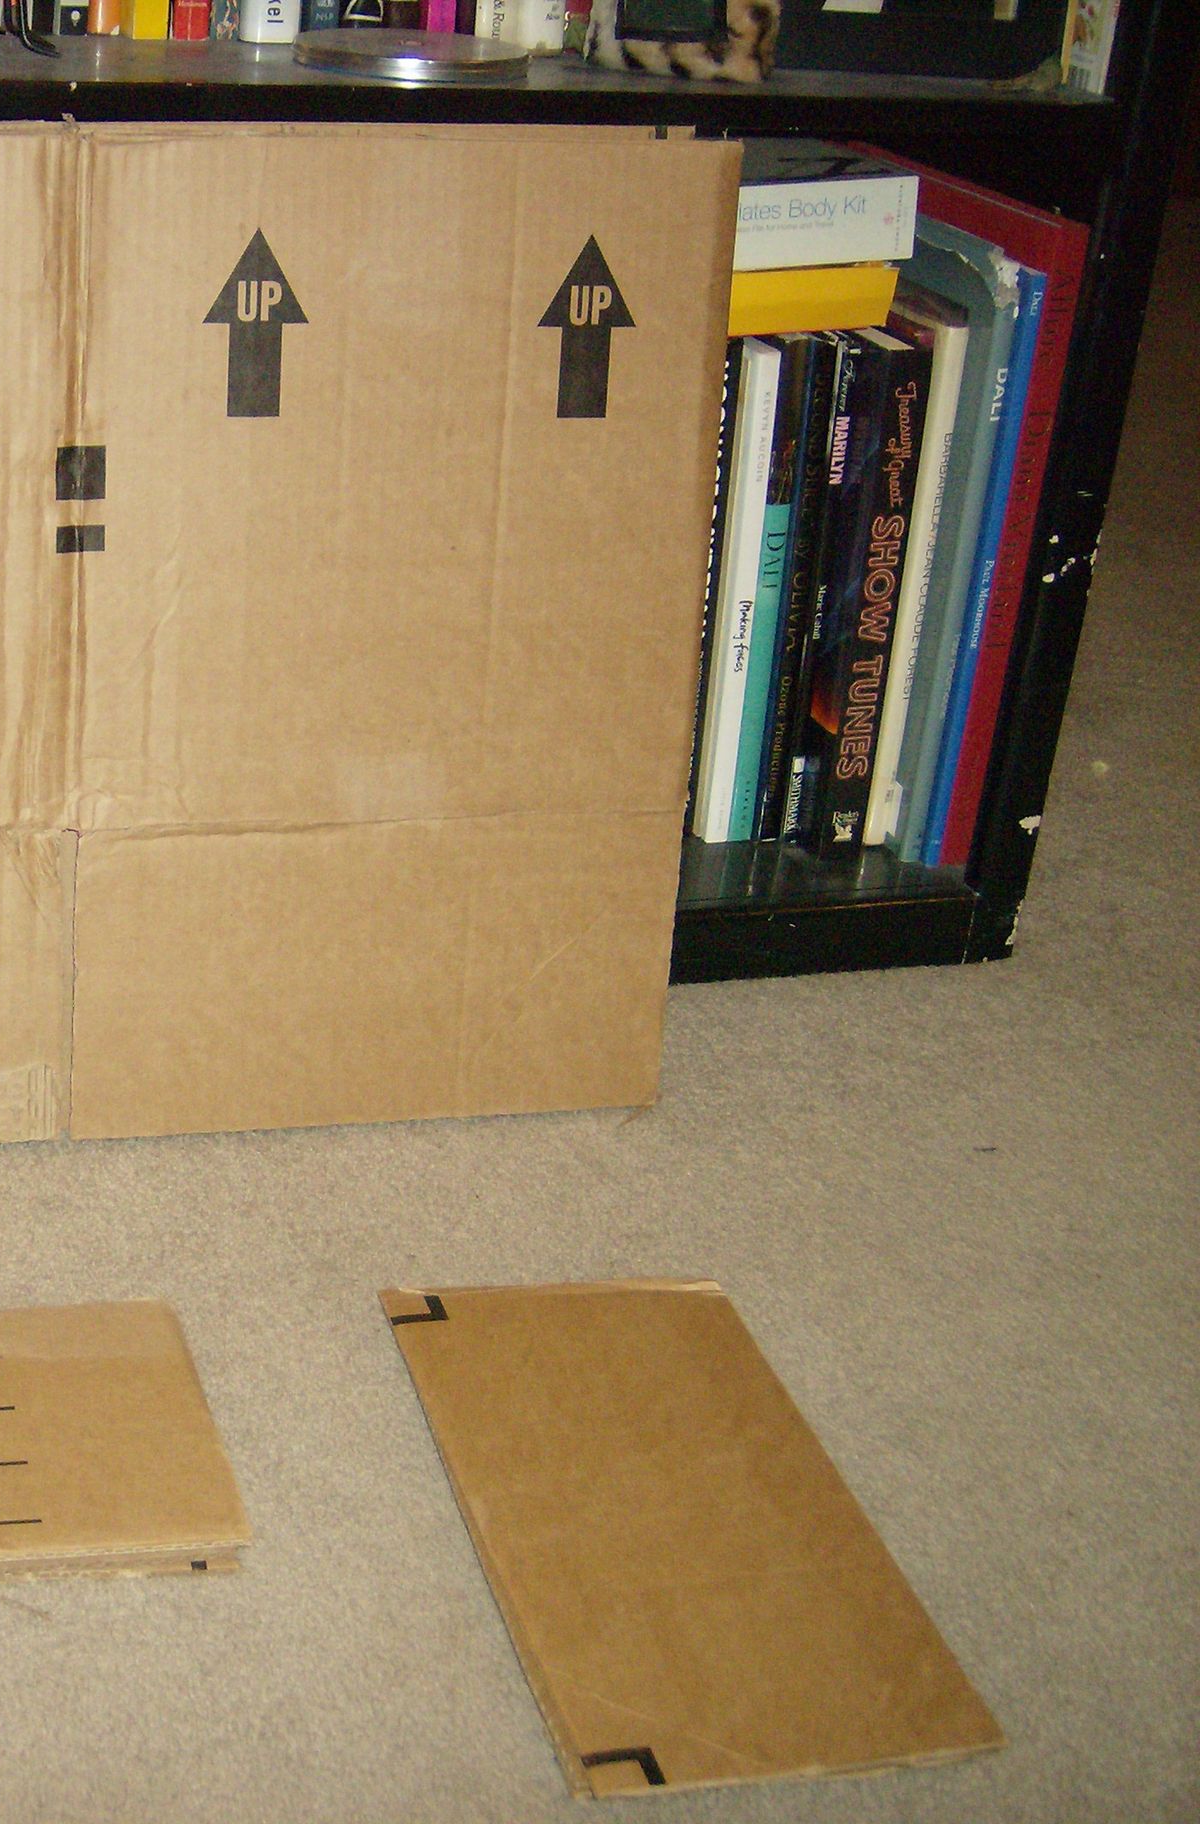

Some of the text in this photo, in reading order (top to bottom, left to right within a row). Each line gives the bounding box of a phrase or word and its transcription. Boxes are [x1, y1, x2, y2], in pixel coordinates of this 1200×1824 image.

[788, 197, 837, 222] Body
[843, 195, 867, 215] Kit
[237, 280, 283, 322] UP
[569, 284, 613, 326] UP
[760, 390, 771, 433] KEVYN
[988, 367, 1009, 422] DALI
[894, 380, 917, 459] Treasury
[829, 415, 852, 486] MARILYN
[881, 459, 905, 508] Great
[858, 514, 905, 643] SHOW
[734, 599, 755, 642] Making
[835, 656, 884, 781] TUNES
